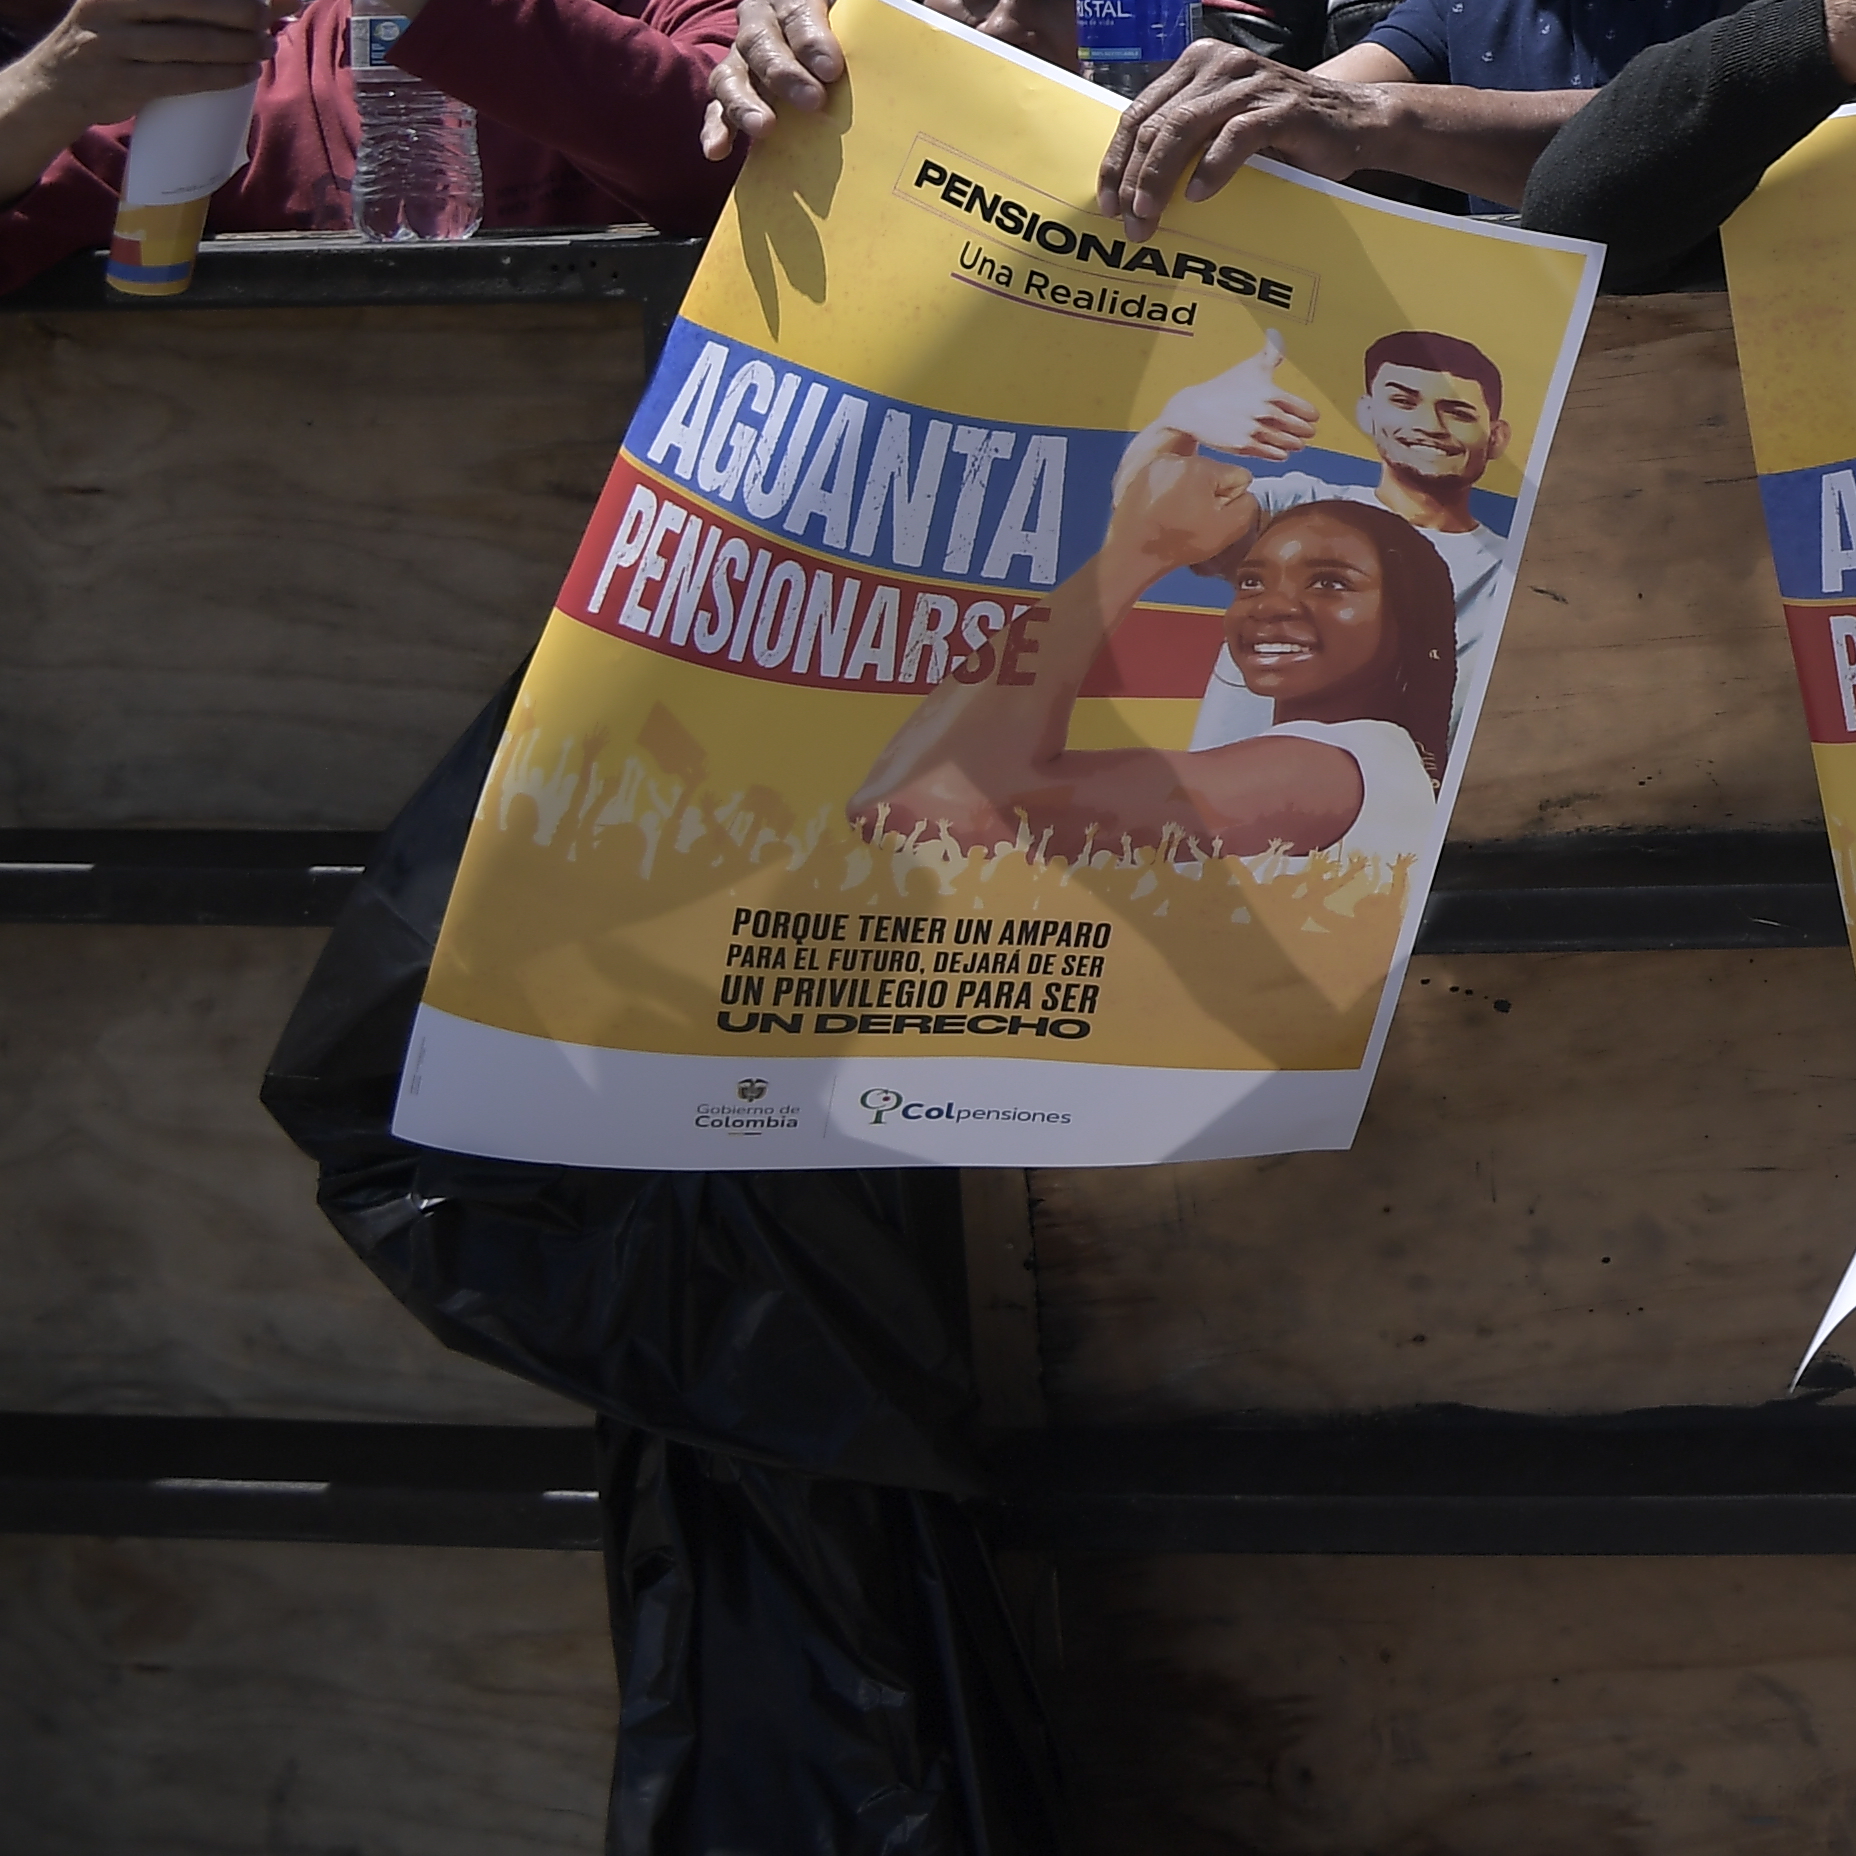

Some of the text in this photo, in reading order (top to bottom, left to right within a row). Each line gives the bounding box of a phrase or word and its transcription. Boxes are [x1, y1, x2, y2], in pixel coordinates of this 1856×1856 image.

[914, 158, 1293, 310] PENSIONARSE
[958, 241, 1197, 327] Una Realidad
[647, 341, 1068, 584] AGUANTA
[588, 483, 1051, 686] PENSIONARSE
[732, 908, 1111, 949] PORQUE TENER UN AMPARO
[725, 944, 1104, 978] PARA EL FUTURO, DEJARÁ DE SER
[720, 974, 1100, 1014] UN PRIVILEGIO PARA SER
[716, 1011, 1091, 1039] UN DERECHO
[694, 1114, 799, 1129] Colombia
[697, 1103, 800, 1116] Gobierno de
[901, 1101, 1072, 1126] Colpensiones
